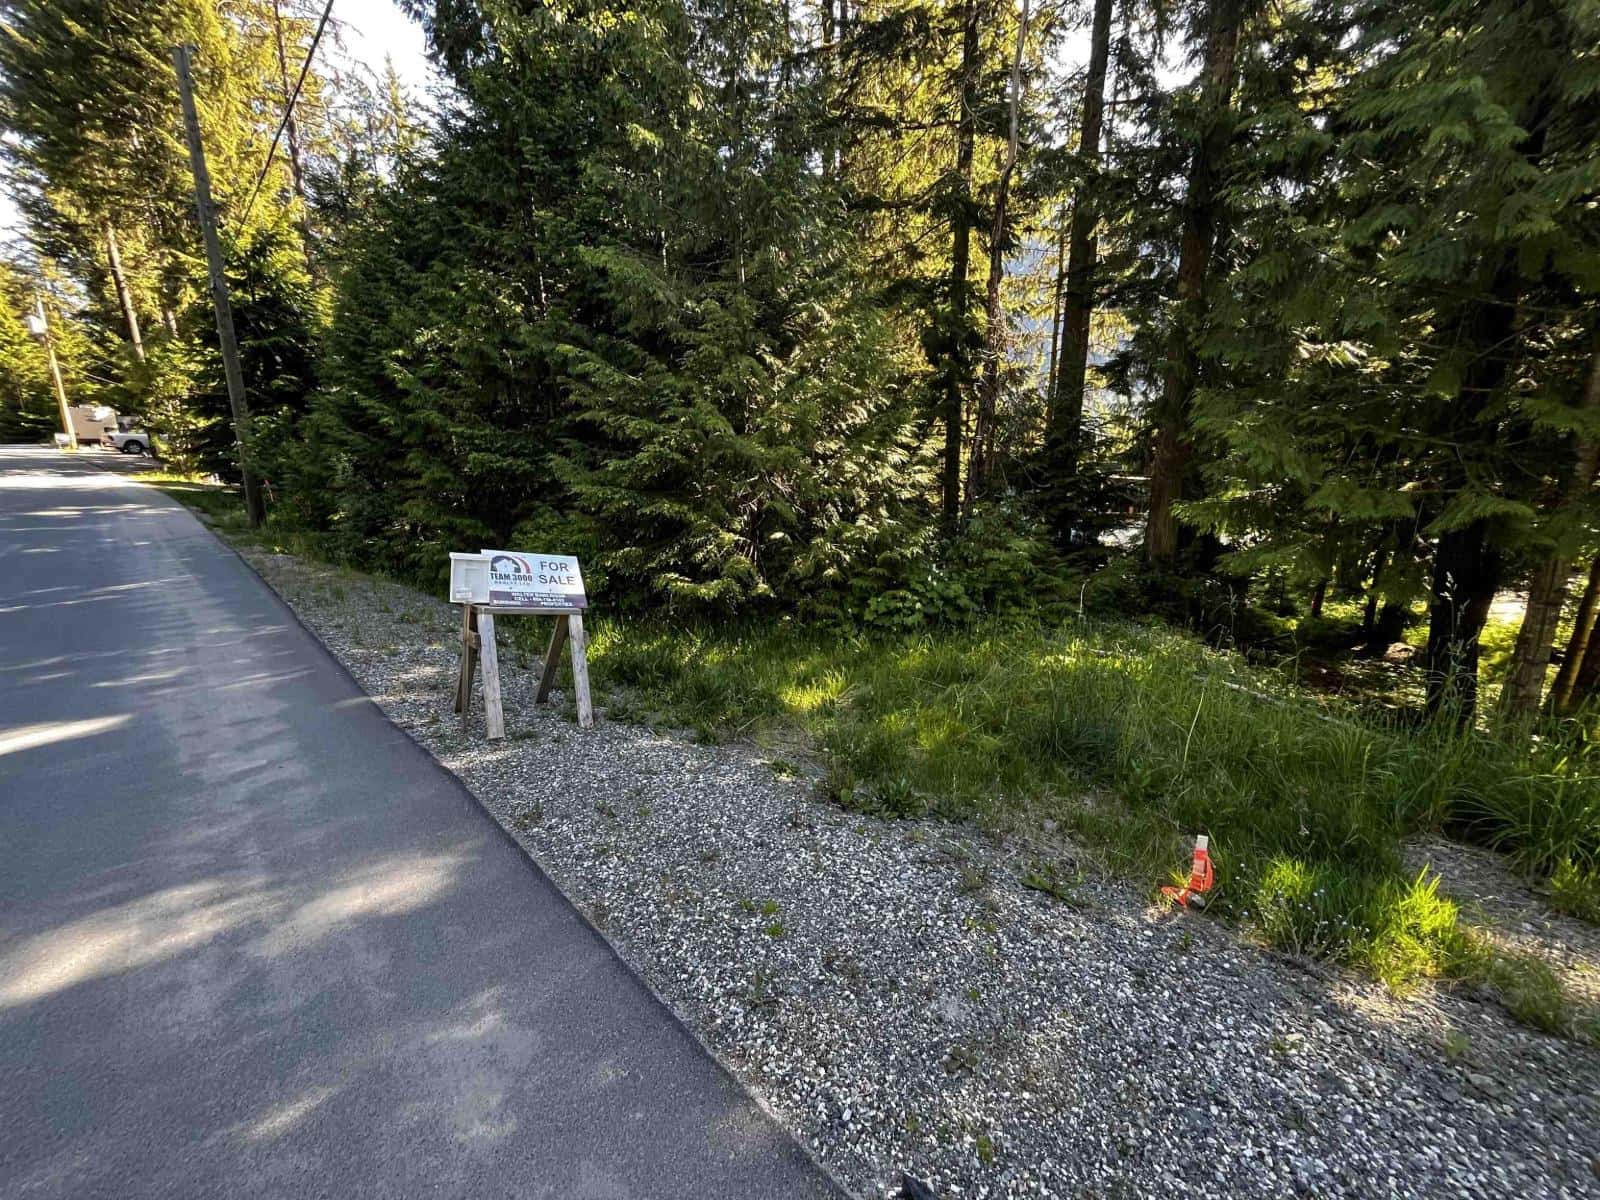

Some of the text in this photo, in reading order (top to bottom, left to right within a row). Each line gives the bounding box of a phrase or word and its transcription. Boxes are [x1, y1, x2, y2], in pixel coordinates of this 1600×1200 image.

[540, 560, 569, 572] FOR
[490, 573, 533, 582] TEAM 3000
[539, 574, 576, 585] SALE
